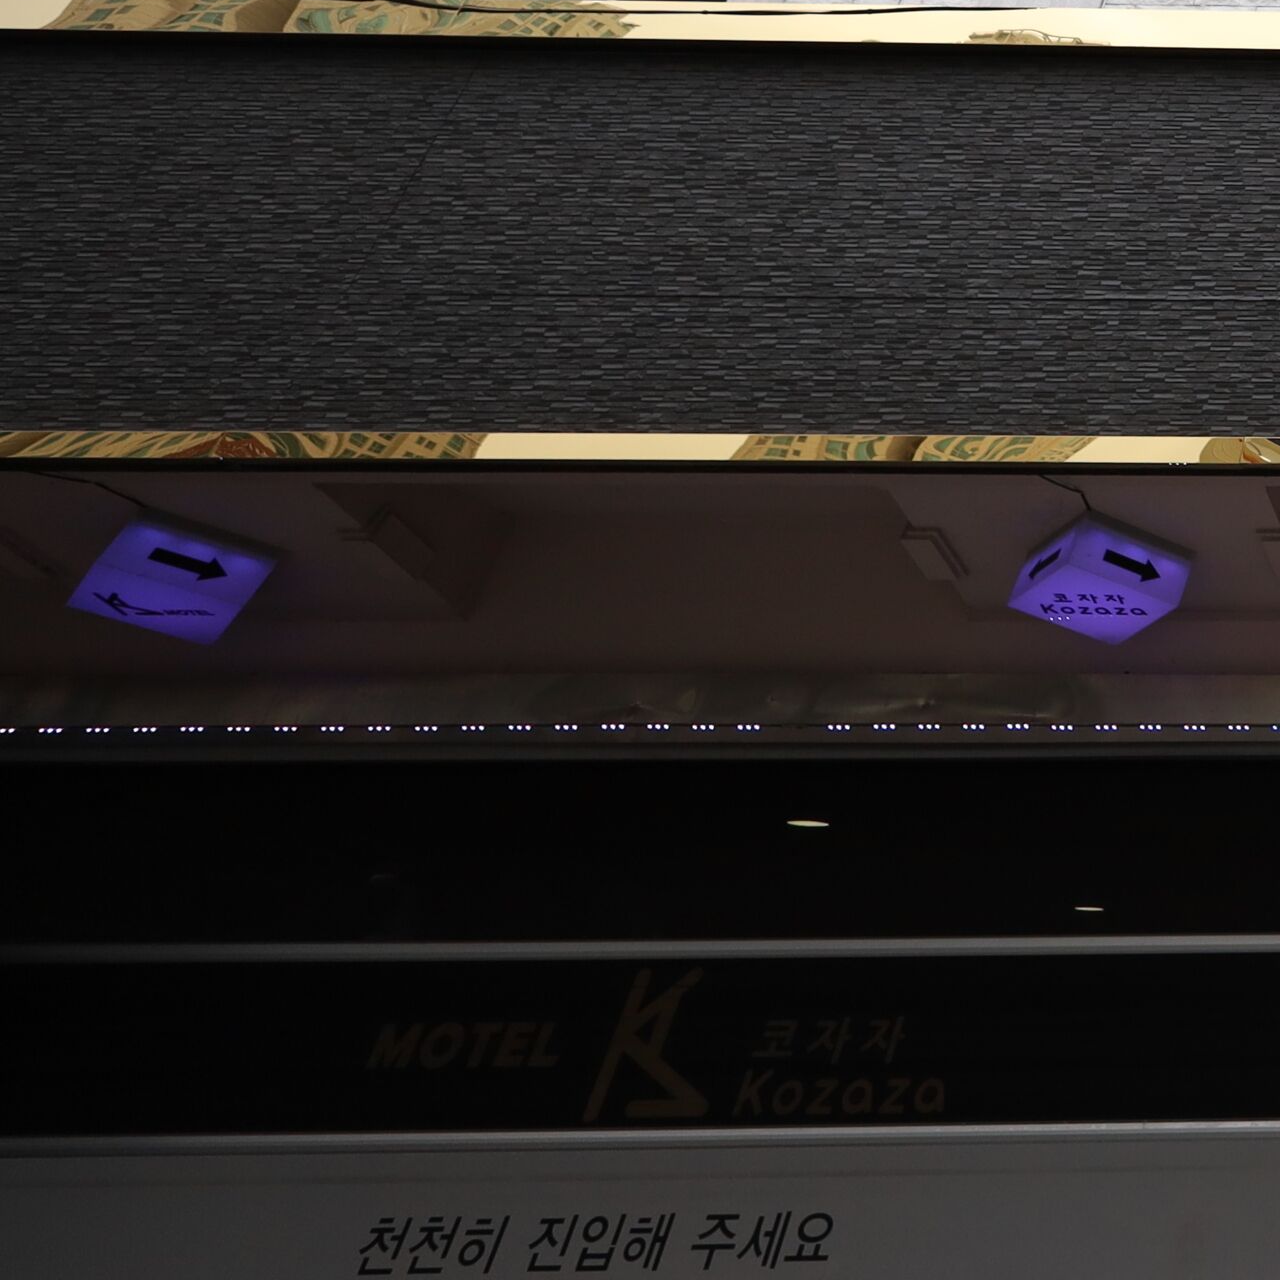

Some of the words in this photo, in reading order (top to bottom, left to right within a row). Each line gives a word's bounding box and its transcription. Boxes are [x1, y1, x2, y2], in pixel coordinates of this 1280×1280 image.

[1040, 604, 1148, 616] Kozaza
[1053, 593, 1125, 604] 코자자
[366, 1021, 560, 1071] MOTEL
[751, 1016, 907, 1062] 코자자
[732, 1070, 946, 1118] Kozaza
[356, 1215, 510, 1276] 천천히
[526, 1214, 675, 1274] 진입해
[690, 1210, 834, 1266] 주세요
